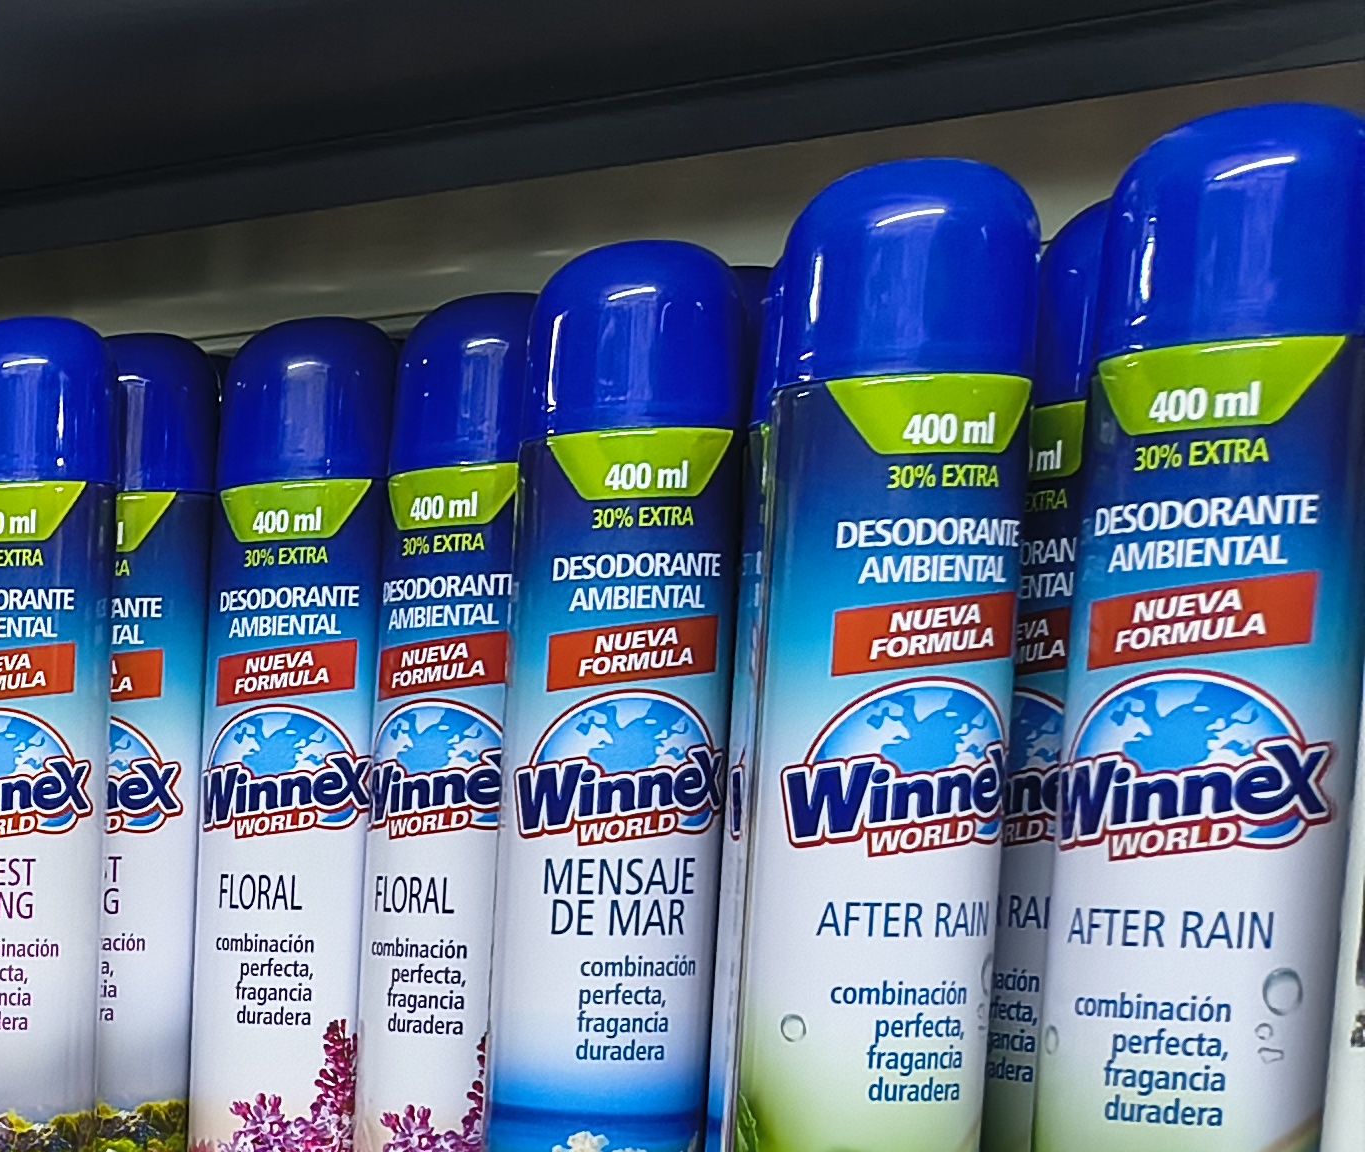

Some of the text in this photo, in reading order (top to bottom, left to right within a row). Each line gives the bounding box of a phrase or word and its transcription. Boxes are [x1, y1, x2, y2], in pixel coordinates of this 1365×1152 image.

[1148, 380, 1262, 423] 400 ml
[1133, 437, 1269, 472] 30% EXTRA
[604, 460, 689, 491] 400 ml
[9, 509, 37, 534] ml
[252, 506, 322, 534] 400 ml
[592, 506, 694, 529] 30% EXTRA
[1093, 494, 1319, 537] DESODORANTE
[836, 517, 1020, 549] DESODORANTE
[244, 546, 329, 568] 30% EXTRA
[552, 552, 721, 582] DESODORANTE
[858, 554, 1007, 585] AMBIENTAL
[1107, 535, 1288, 574] AMBIENTAL
[568, 584, 705, 612] AMBIENTAL
[1132, 588, 1242, 624] NUEVA
[889, 603, 981, 633] NUEVA
[1114, 612, 1266, 653] FORMULA
[594, 627, 678, 654] NUEVA
[869, 627, 994, 660] FORMULA
[578, 647, 693, 677] FORMULA
[578, 813, 678, 845] WORLD
[869, 819, 976, 856] WORLD
[1110, 821, 1239, 859] WORLD
[219, 873, 303, 911] FLORAL
[543, 857, 696, 895] MENSAJE
[550, 899, 685, 936] DE MAR
[816, 900, 989, 938] AFTER RAIN
[1067, 907, 1274, 951] AFTER RAIN
[215, 933, 315, 954] combinación
[240, 958, 314, 981] perfecta,
[580, 954, 696, 977] combinación
[235, 982, 312, 1004] fragancia
[578, 982, 667, 1010] perfecta,
[1074, 991, 1232, 1024] combinación
[236, 1005, 311, 1026] duradera
[577, 1011, 669, 1038] fragancia
[576, 1038, 665, 1061] duradera
[1112, 1028, 1229, 1061] perfecta,
[1103, 1061, 1227, 1094] fragancia
[1104, 1095, 1224, 1127] duradera
